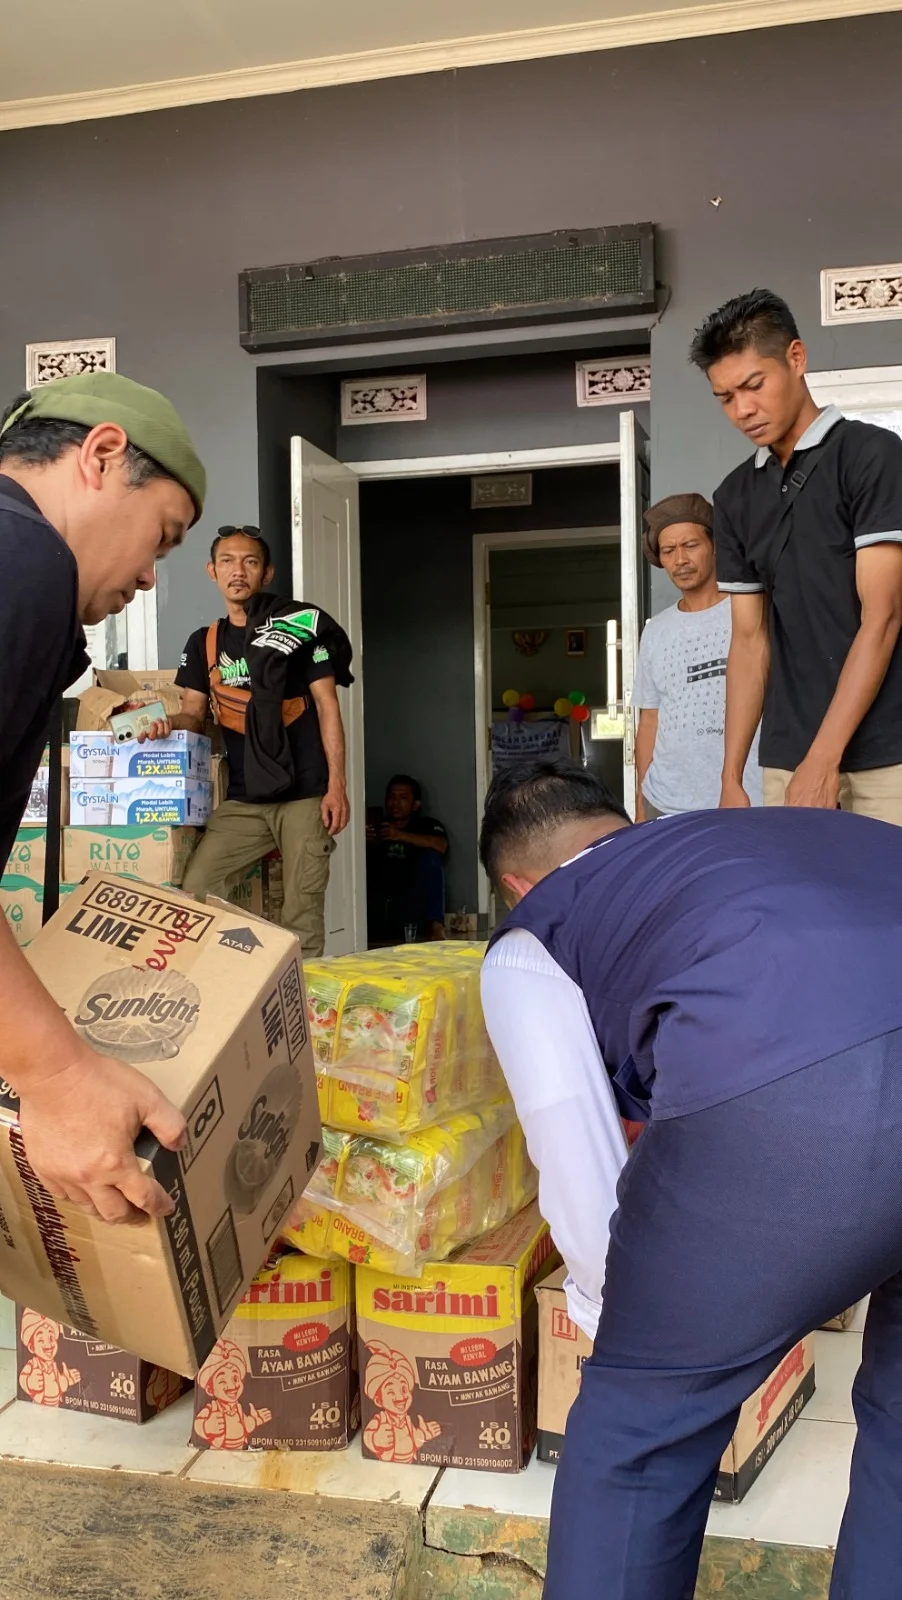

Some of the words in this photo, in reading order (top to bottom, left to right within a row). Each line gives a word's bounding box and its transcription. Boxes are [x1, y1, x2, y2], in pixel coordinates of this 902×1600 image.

[136, 764, 161, 776] 1,2X
[135, 812, 159, 823] 1,2X
[90, 862, 139, 872] WATER
[95, 886, 205, 933] 68911707
[65, 909, 147, 951] LIME
[221, 938, 253, 952] ATAS
[74, 992, 200, 1026] Sunlight
[261, 988, 284, 1058] LIME
[333, 1217, 365, 1242] BRAND
[239, 1270, 333, 1304] rimi
[372, 1281, 501, 1318] sarimi
[296, 1336, 320, 1346] KENYAL
[258, 1349, 281, 1358] RASA
[261, 1359, 295, 1373] AYAM
[296, 1342, 344, 1369] BAWANG
[463, 1352, 487, 1361] KENYAL
[425, 1360, 448, 1370] RASA
[111, 1371, 133, 1380] ISI
[292, 1373, 316, 1386] MINYAK
[316, 1363, 342, 1379] BAWANG
[428, 1372, 462, 1386] AYAM
[463, 1361, 513, 1385] BAWANG
[109, 1377, 136, 1395] 40
[460, 1390, 483, 1401] MINYAK
[484, 1382, 511, 1397] BAWANG
[65, 1396, 83, 1406] BPOM
[110, 1391, 136, 1400] BKS
[311, 1400, 338, 1409] ISI
[309, 1407, 341, 1425] 40
[309, 1422, 341, 1430] BKS
[480, 1421, 508, 1429] ISI
[251, 1437, 274, 1446] BPOM
[478, 1427, 511, 1445] 40
[420, 1453, 441, 1463] BPOM
[443, 1454, 451, 1464] RI
[453, 1456, 463, 1465] MD
[464, 1457, 513, 1468] 231509104002
